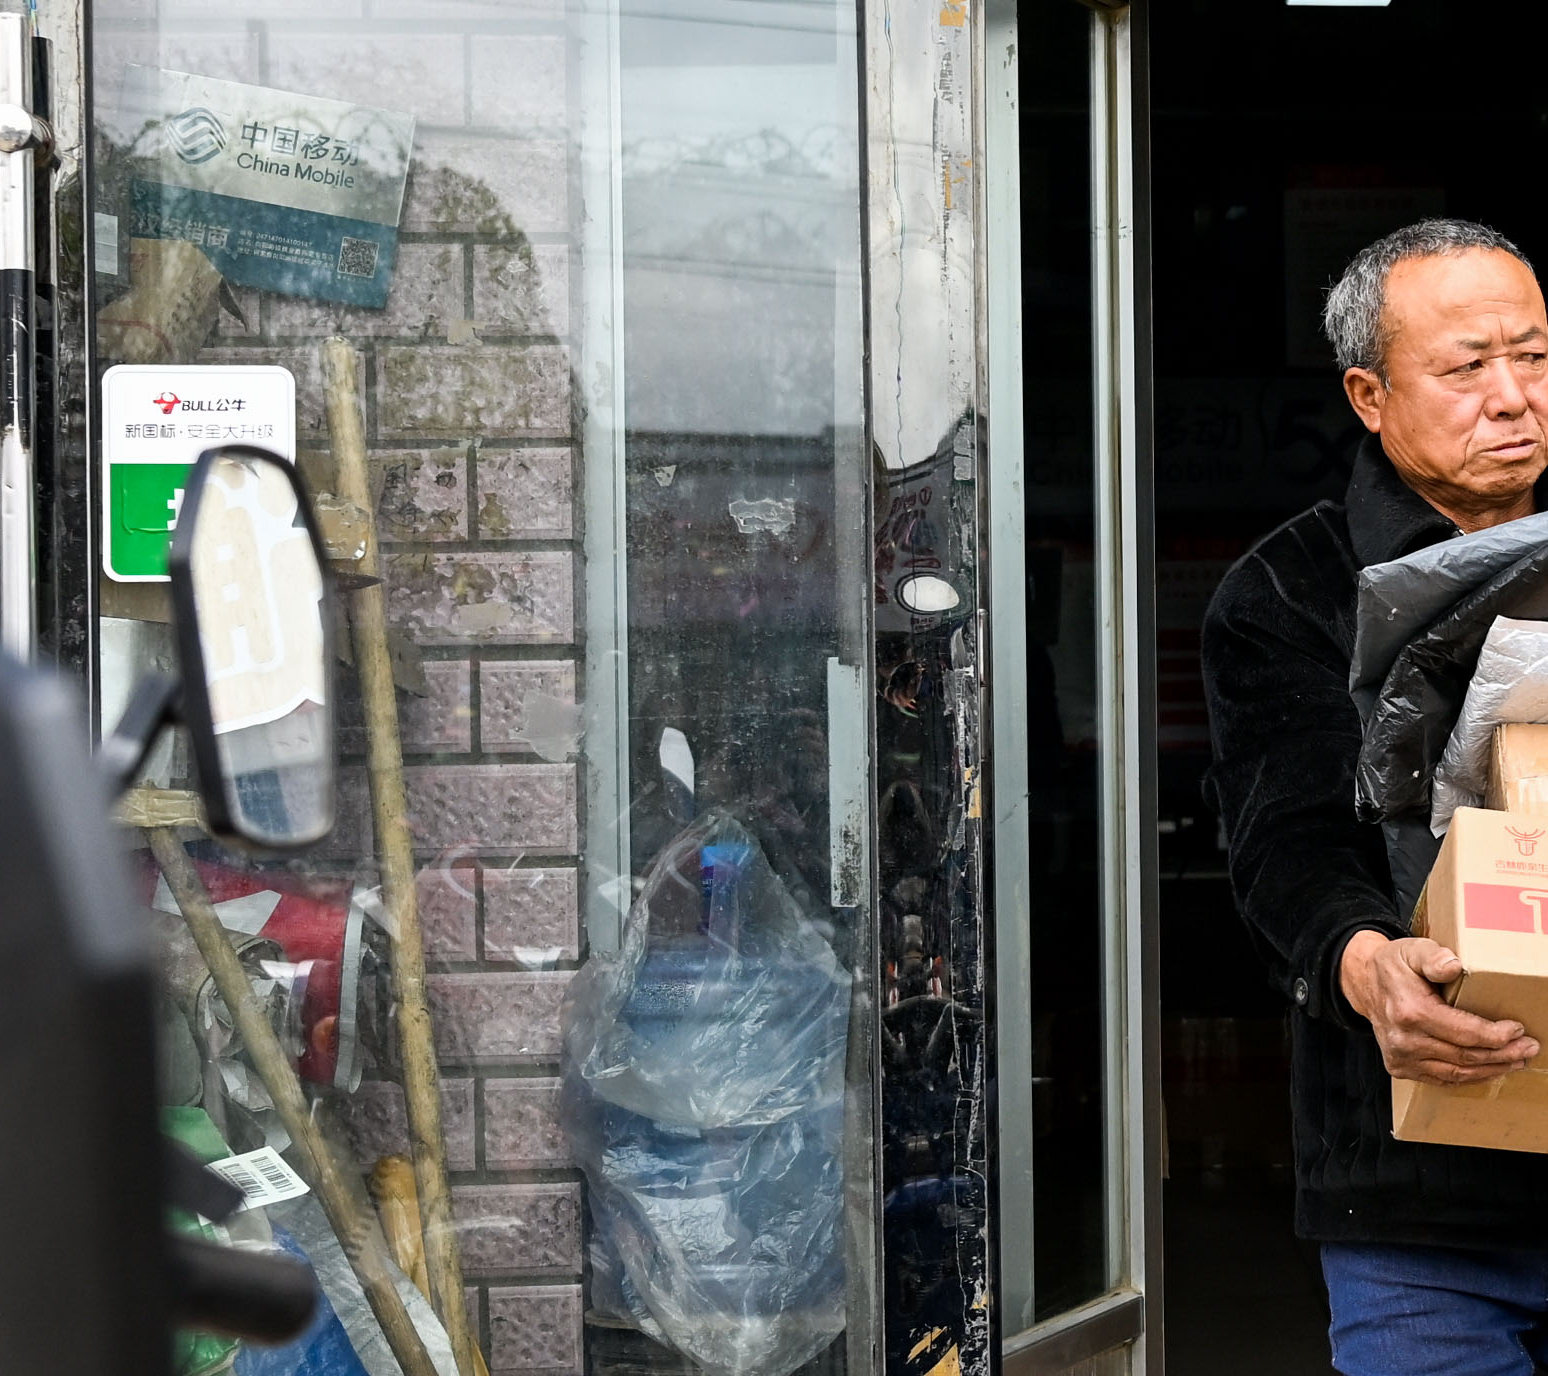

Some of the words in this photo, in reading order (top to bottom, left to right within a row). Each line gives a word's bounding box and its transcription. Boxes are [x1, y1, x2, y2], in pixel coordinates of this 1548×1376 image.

[240, 121, 360, 167] 中国移动
[236, 152, 290, 178] China
[294, 162, 356, 189] Mobile
